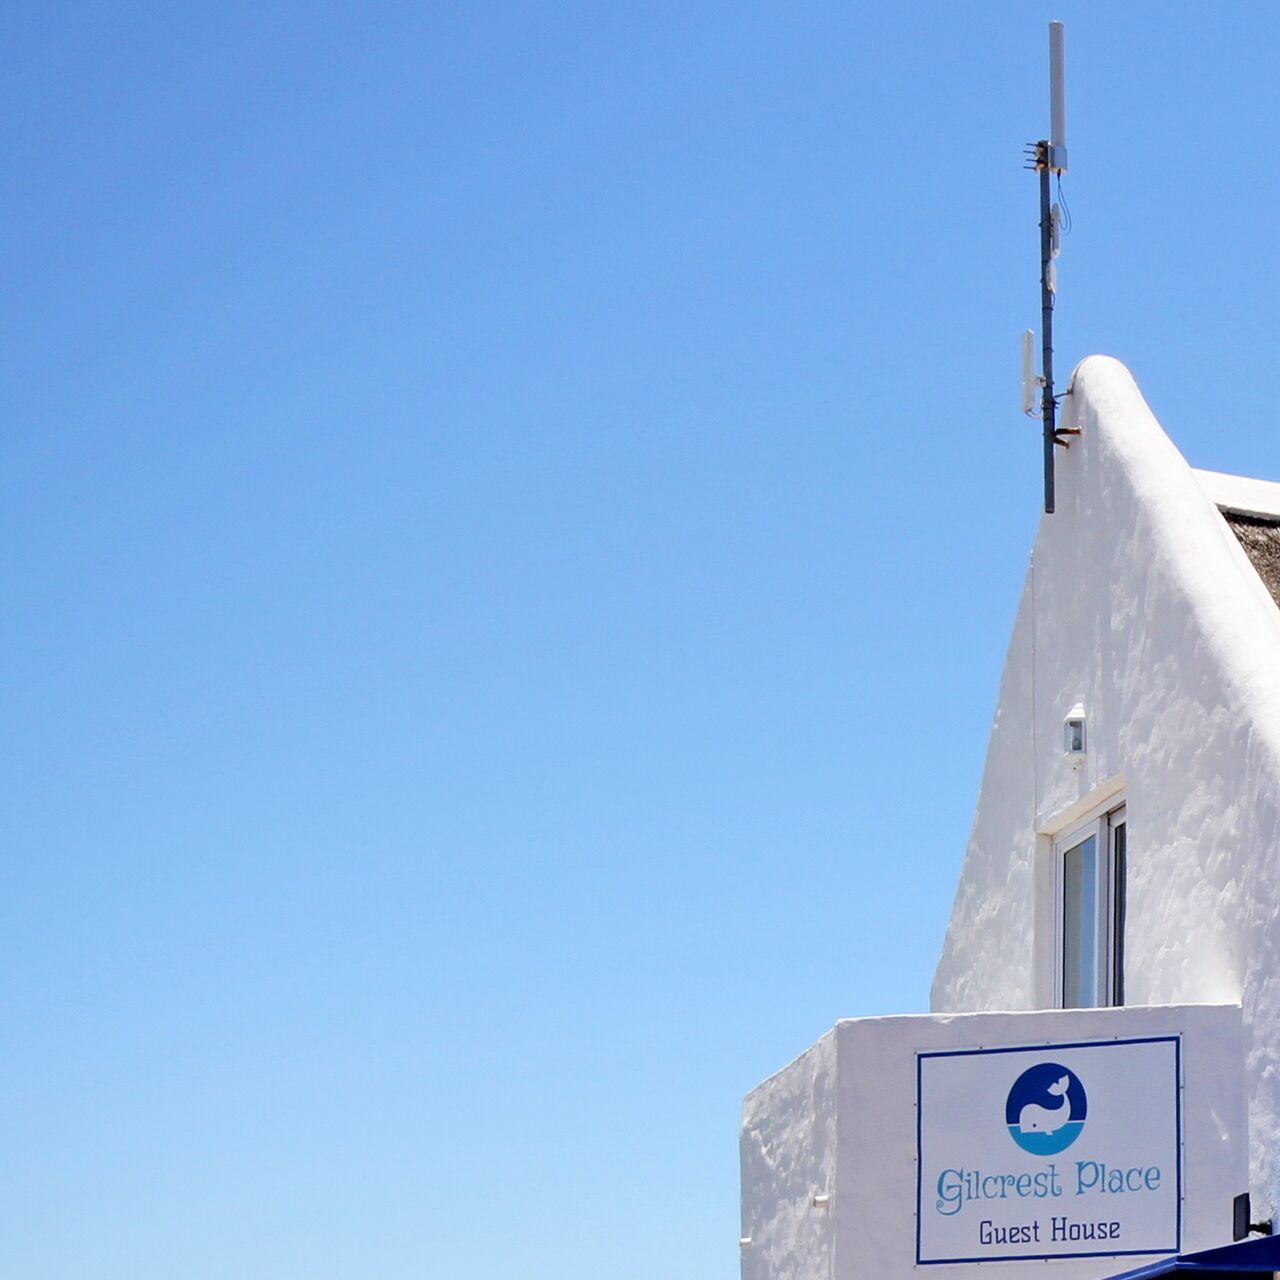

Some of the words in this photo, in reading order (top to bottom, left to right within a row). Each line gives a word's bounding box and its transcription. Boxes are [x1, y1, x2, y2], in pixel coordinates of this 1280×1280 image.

[936, 1164, 1062, 1215] Gilcrest
[1074, 1160, 1160, 1196] Place
[980, 1220, 1040, 1245] Guest
[1050, 1217, 1120, 1242] House
